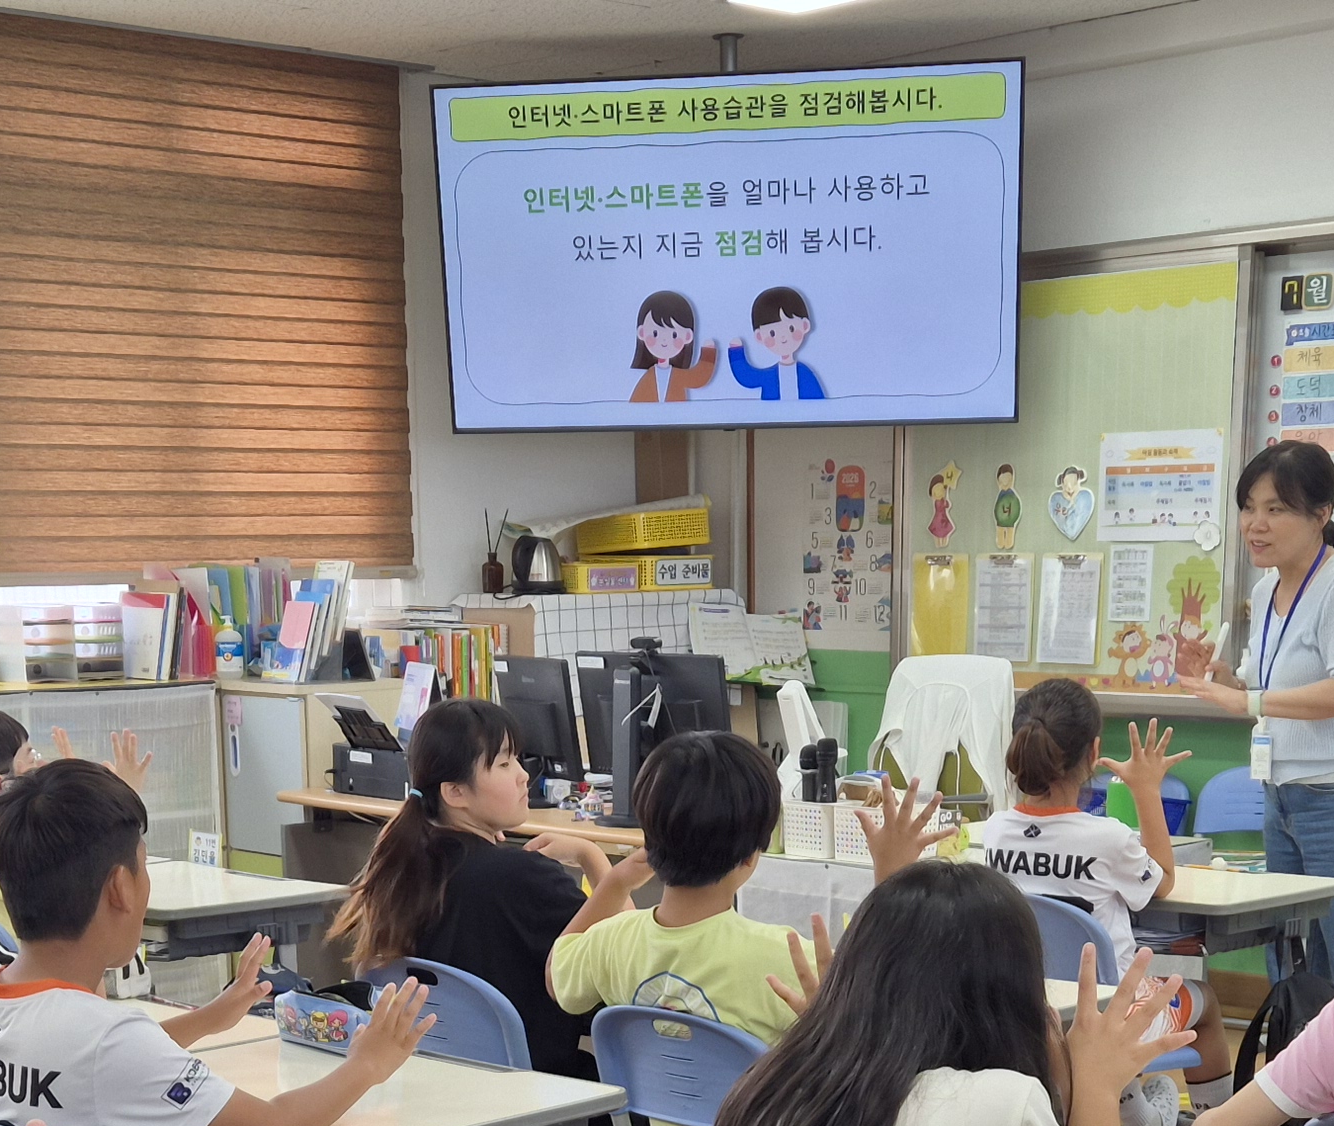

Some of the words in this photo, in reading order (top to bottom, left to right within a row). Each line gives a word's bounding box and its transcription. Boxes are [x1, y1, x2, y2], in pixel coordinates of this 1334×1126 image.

[677, 92, 789, 123] 사용습관을
[798, 86, 945, 117] 점검해봅시다.
[741, 176, 817, 206] 얼마나
[827, 173, 931, 203] 사용하고
[572, 232, 645, 262] 있는지
[655, 231, 704, 259] 지금
[714, 228, 790, 257] 점검해
[799, 224, 883, 254] 봅시다.
[658, 563, 677, 580] 수업
[681, 563, 710, 579] 준비물
[984, 847, 1098, 881] WABUK
